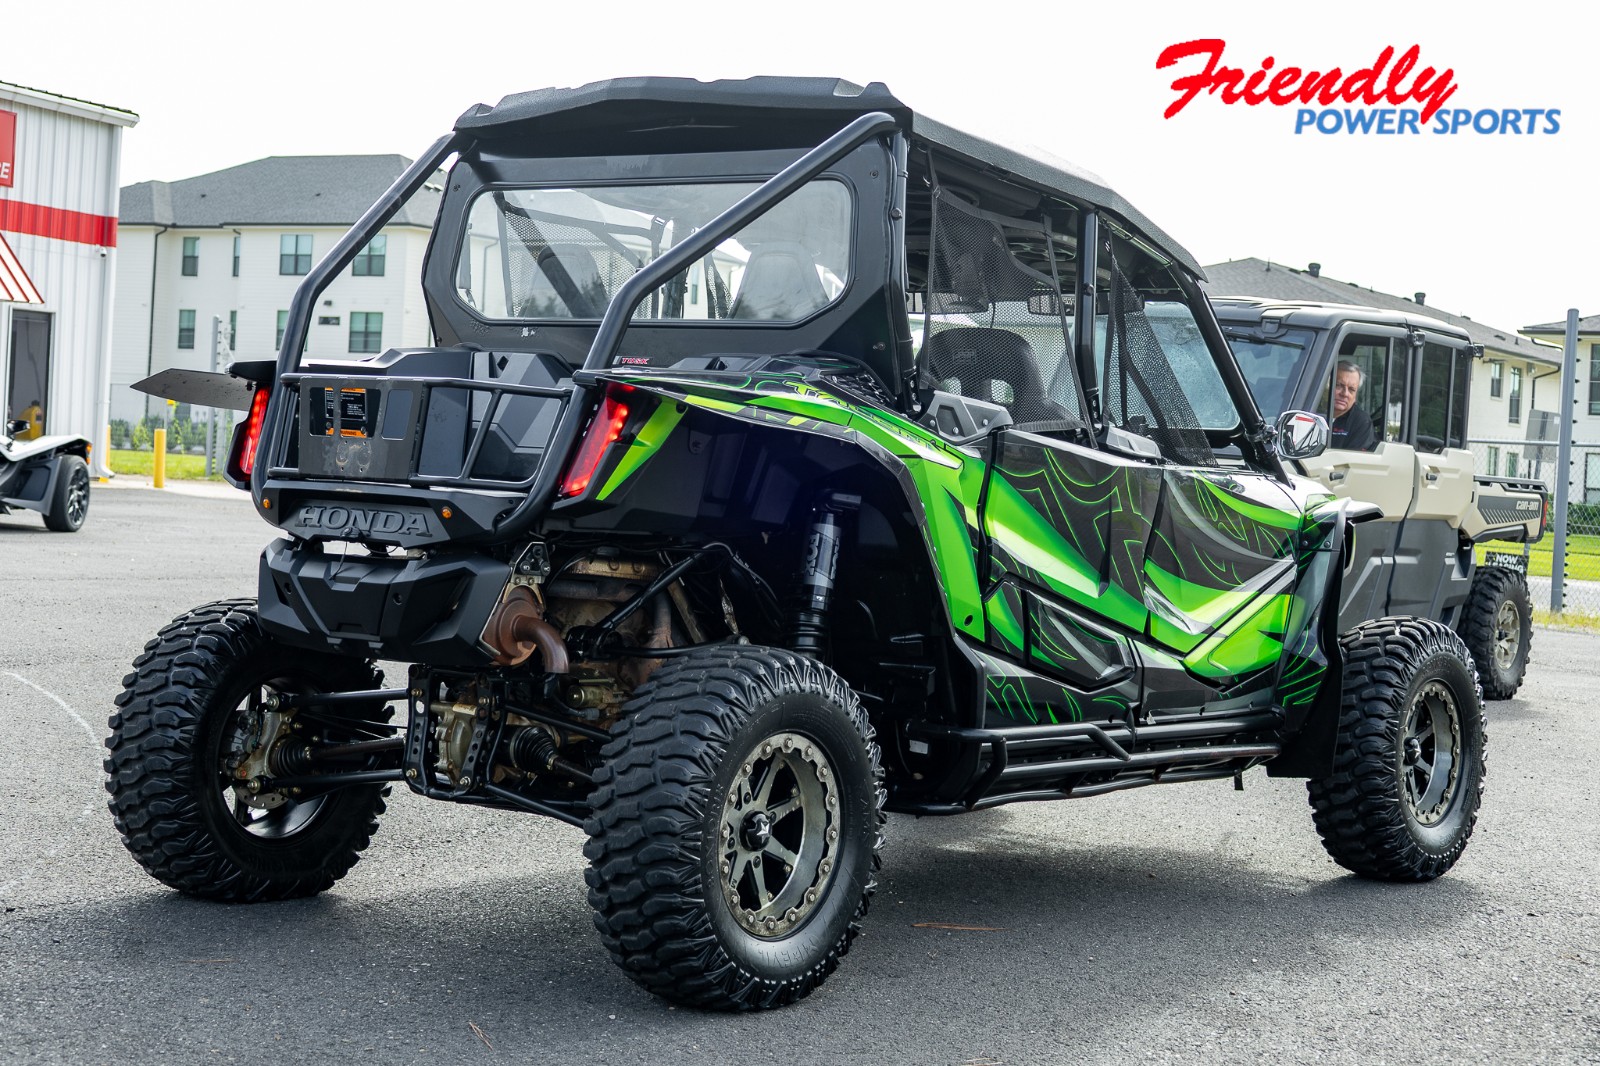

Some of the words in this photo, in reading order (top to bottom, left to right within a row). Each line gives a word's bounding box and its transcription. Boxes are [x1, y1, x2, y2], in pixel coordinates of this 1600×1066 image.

[1516, 501, 1540, 511] can-am
[295, 506, 432, 537] HONDA
[1496, 554, 1519, 564] NOW
